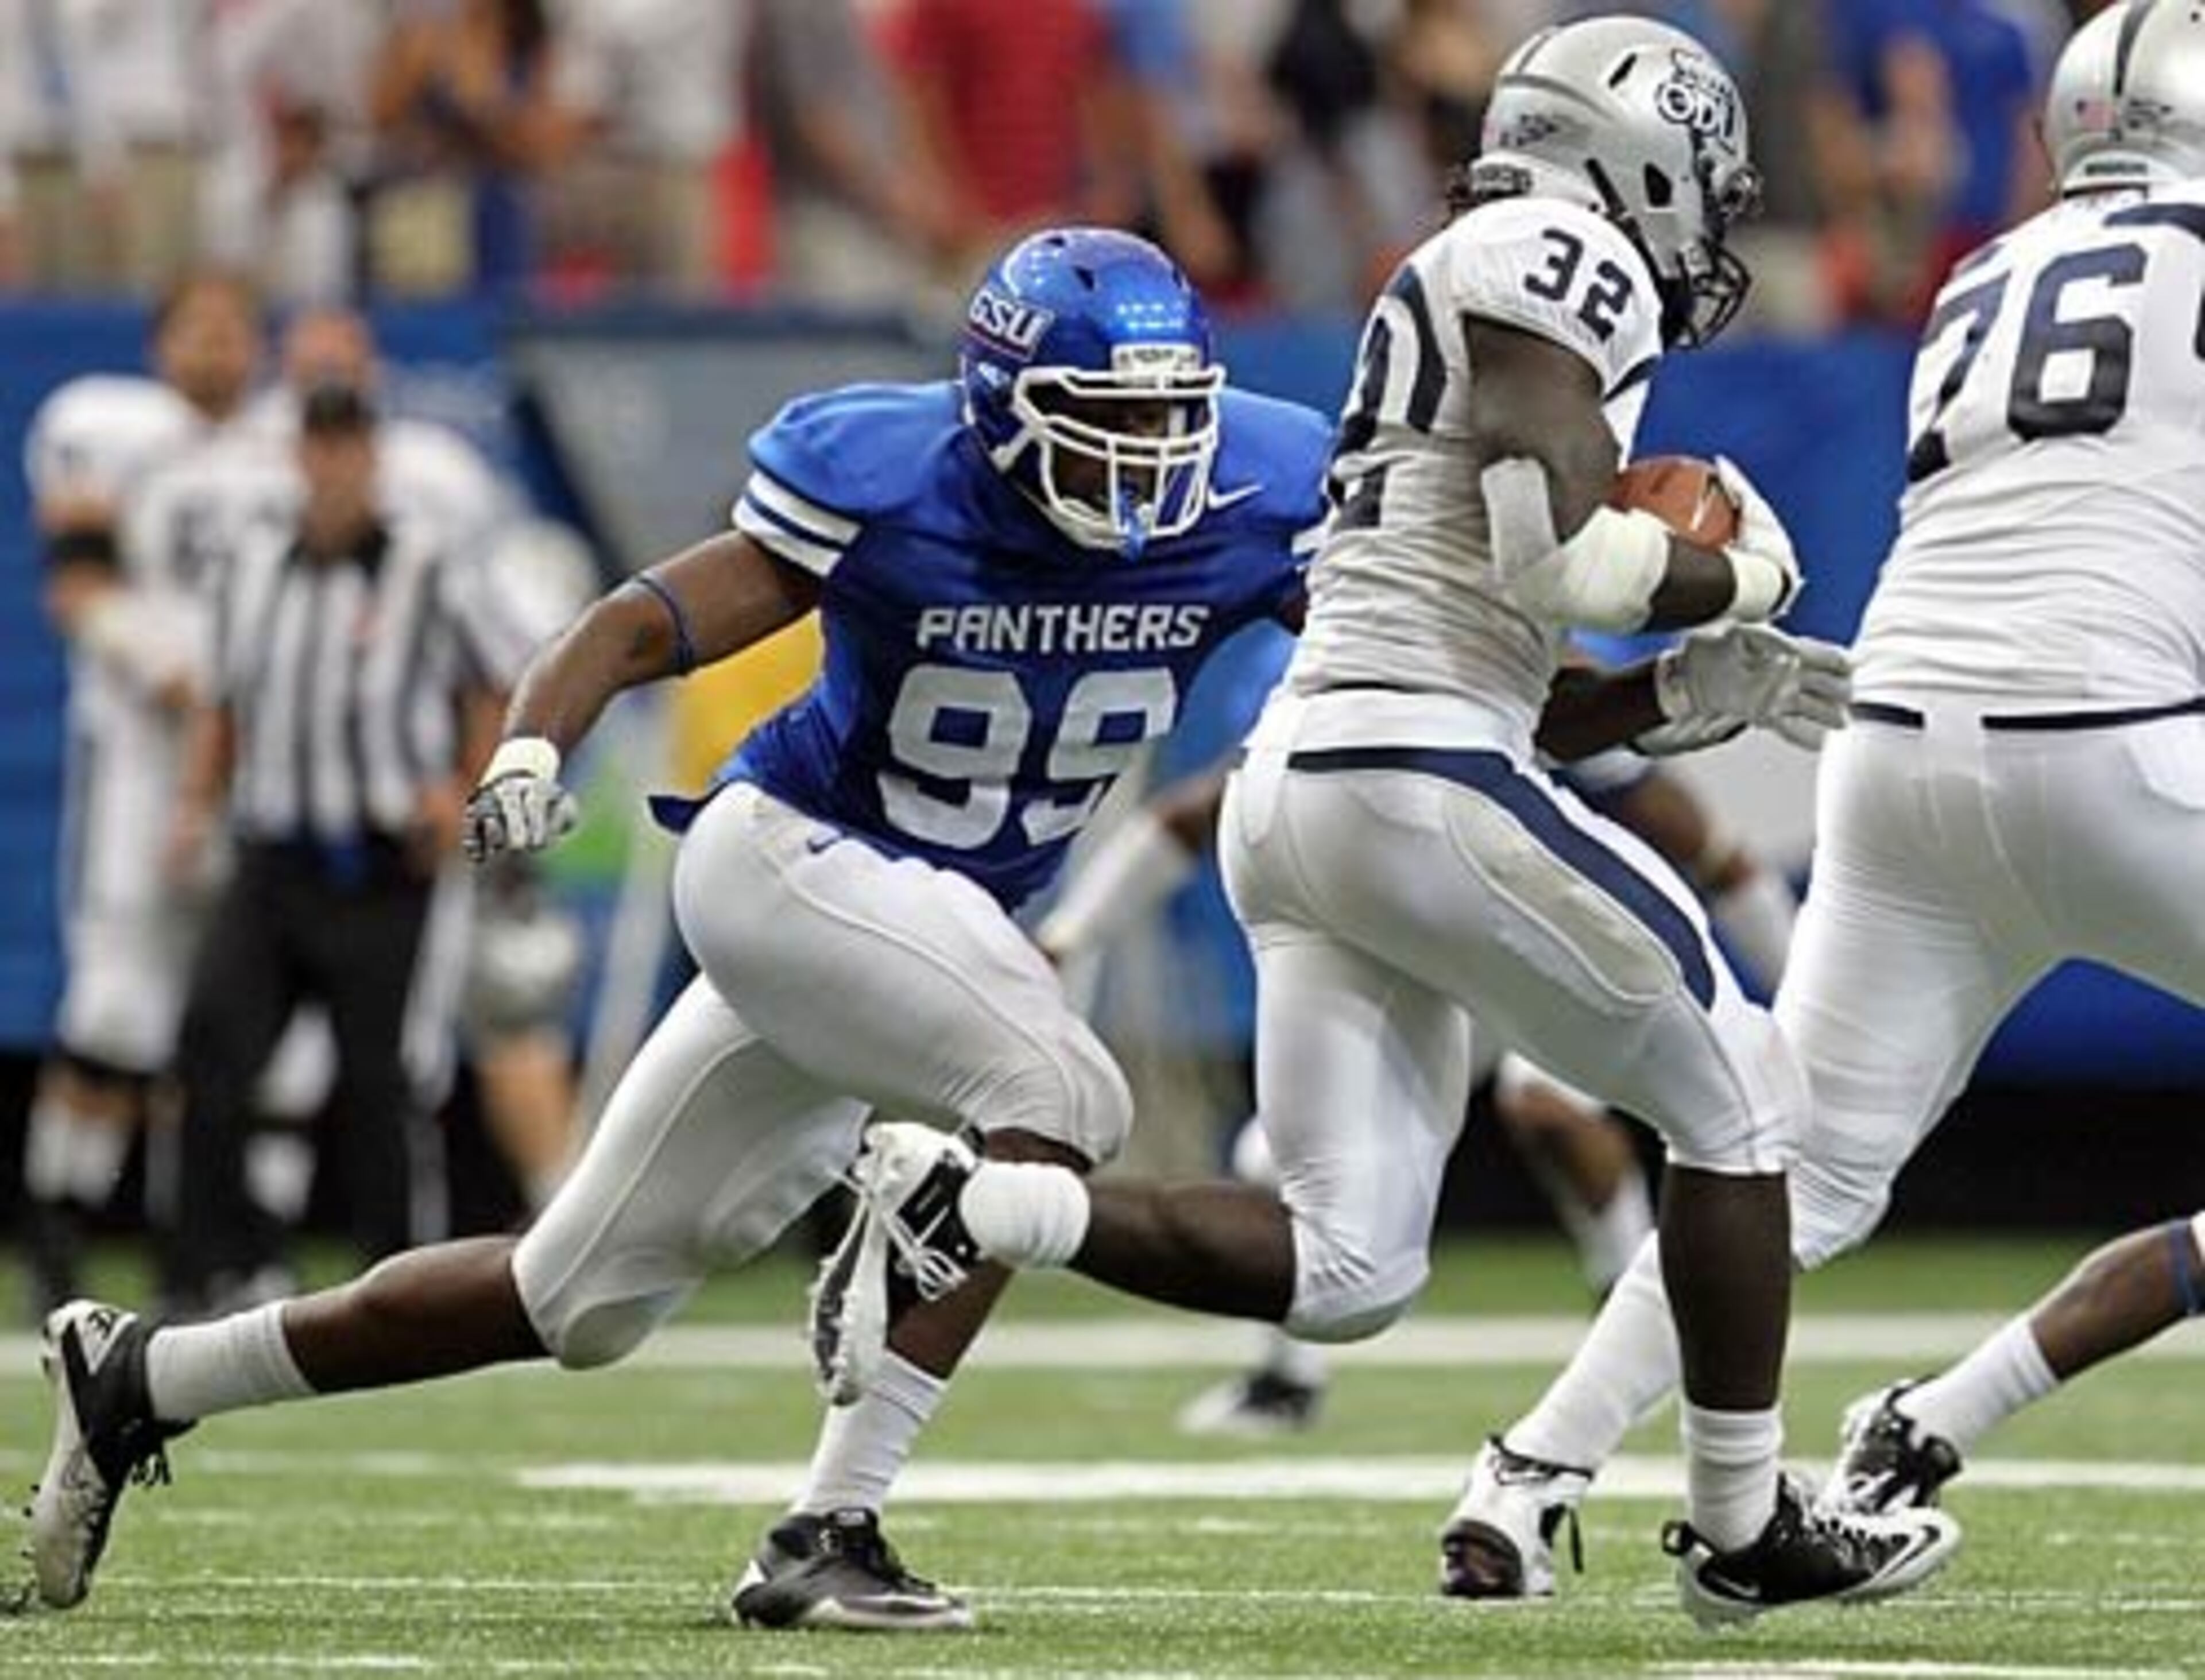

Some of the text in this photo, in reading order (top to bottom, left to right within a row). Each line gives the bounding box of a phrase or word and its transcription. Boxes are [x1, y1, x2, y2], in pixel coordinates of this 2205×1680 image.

[969, 288, 1053, 346] GSU
[1523, 229, 1634, 342] 32
[1905, 242, 2148, 483] 76
[917, 604, 1209, 653] PANTHERS
[876, 663, 1177, 850] 99
